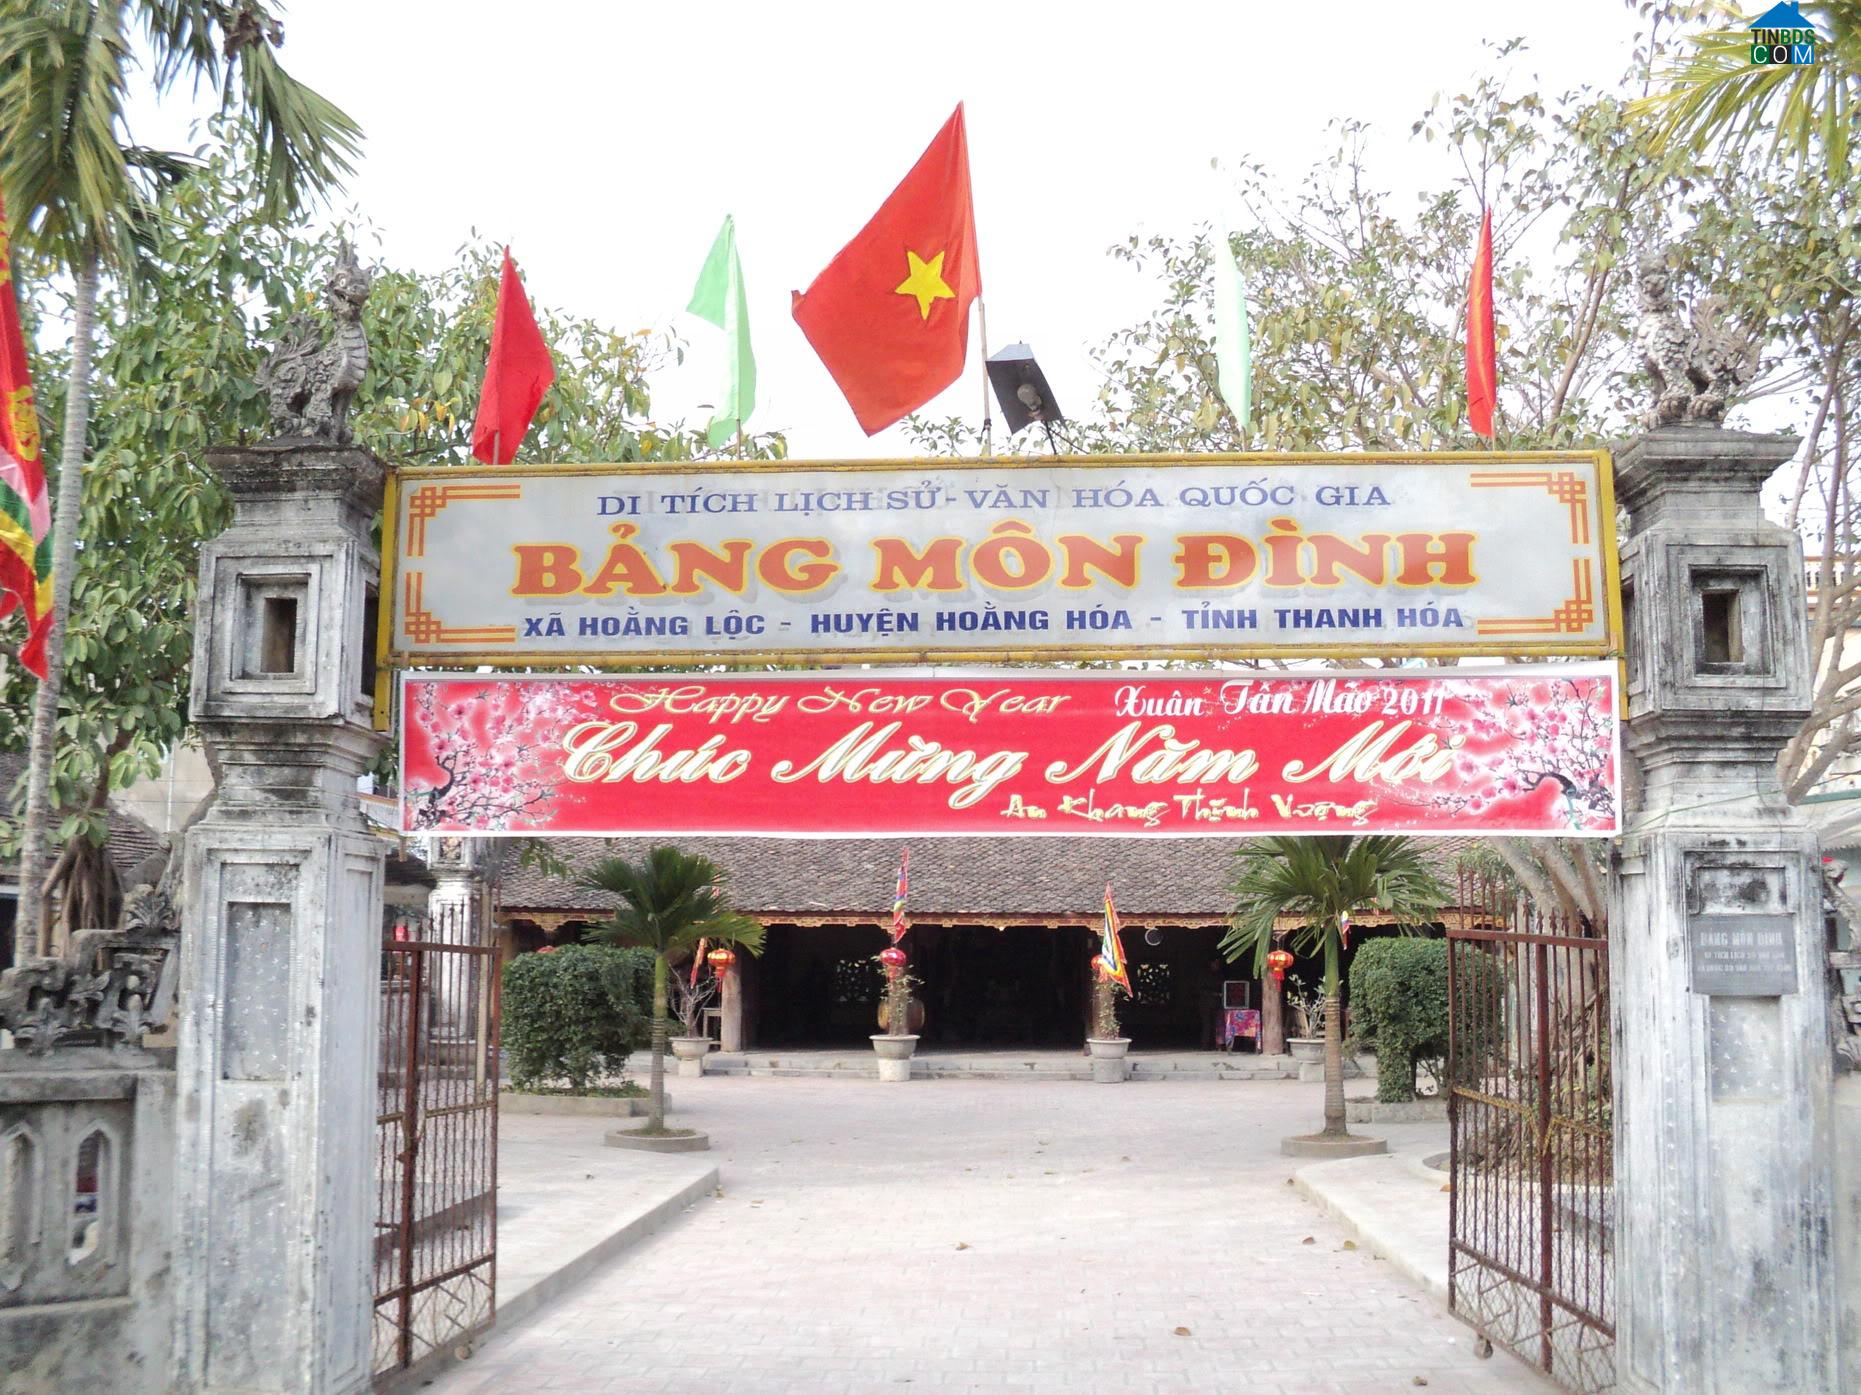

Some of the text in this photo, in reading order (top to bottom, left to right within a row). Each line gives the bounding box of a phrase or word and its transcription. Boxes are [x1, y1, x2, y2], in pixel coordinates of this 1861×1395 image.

[597, 496, 641, 515] DI
[661, 487, 758, 514] TÍCH
[774, 490, 874, 517] LỊCH
[1072, 481, 1161, 509] HÓA
[1178, 479, 1298, 508] QUỐC
[1315, 484, 1391, 507] GIA
[510, 516, 1480, 596] BẢNG MÔN ĐÌNH
[524, 611, 566, 637] XÃ
[578, 606, 688, 637] HOẰNG
[705, 608, 765, 641] LỘC
[811, 606, 919, 638] HUYỆN
[936, 602, 1048, 632] HOẰNG
[1066, 601, 1133, 631] HÓA
[1181, 600, 1257, 630] TỈNH
[1274, 607, 1382, 629] THANH
[1397, 601, 1464, 629] HÓA
[609, 685, 1072, 724] Happy New Year
[1114, 678, 1445, 718] Xuân Tân Mão 2011
[561, 719, 1468, 811] Chúc Mừng Năm Mới
[1003, 795, 1047, 819] An
[1058, 788, 1171, 828] Khang
